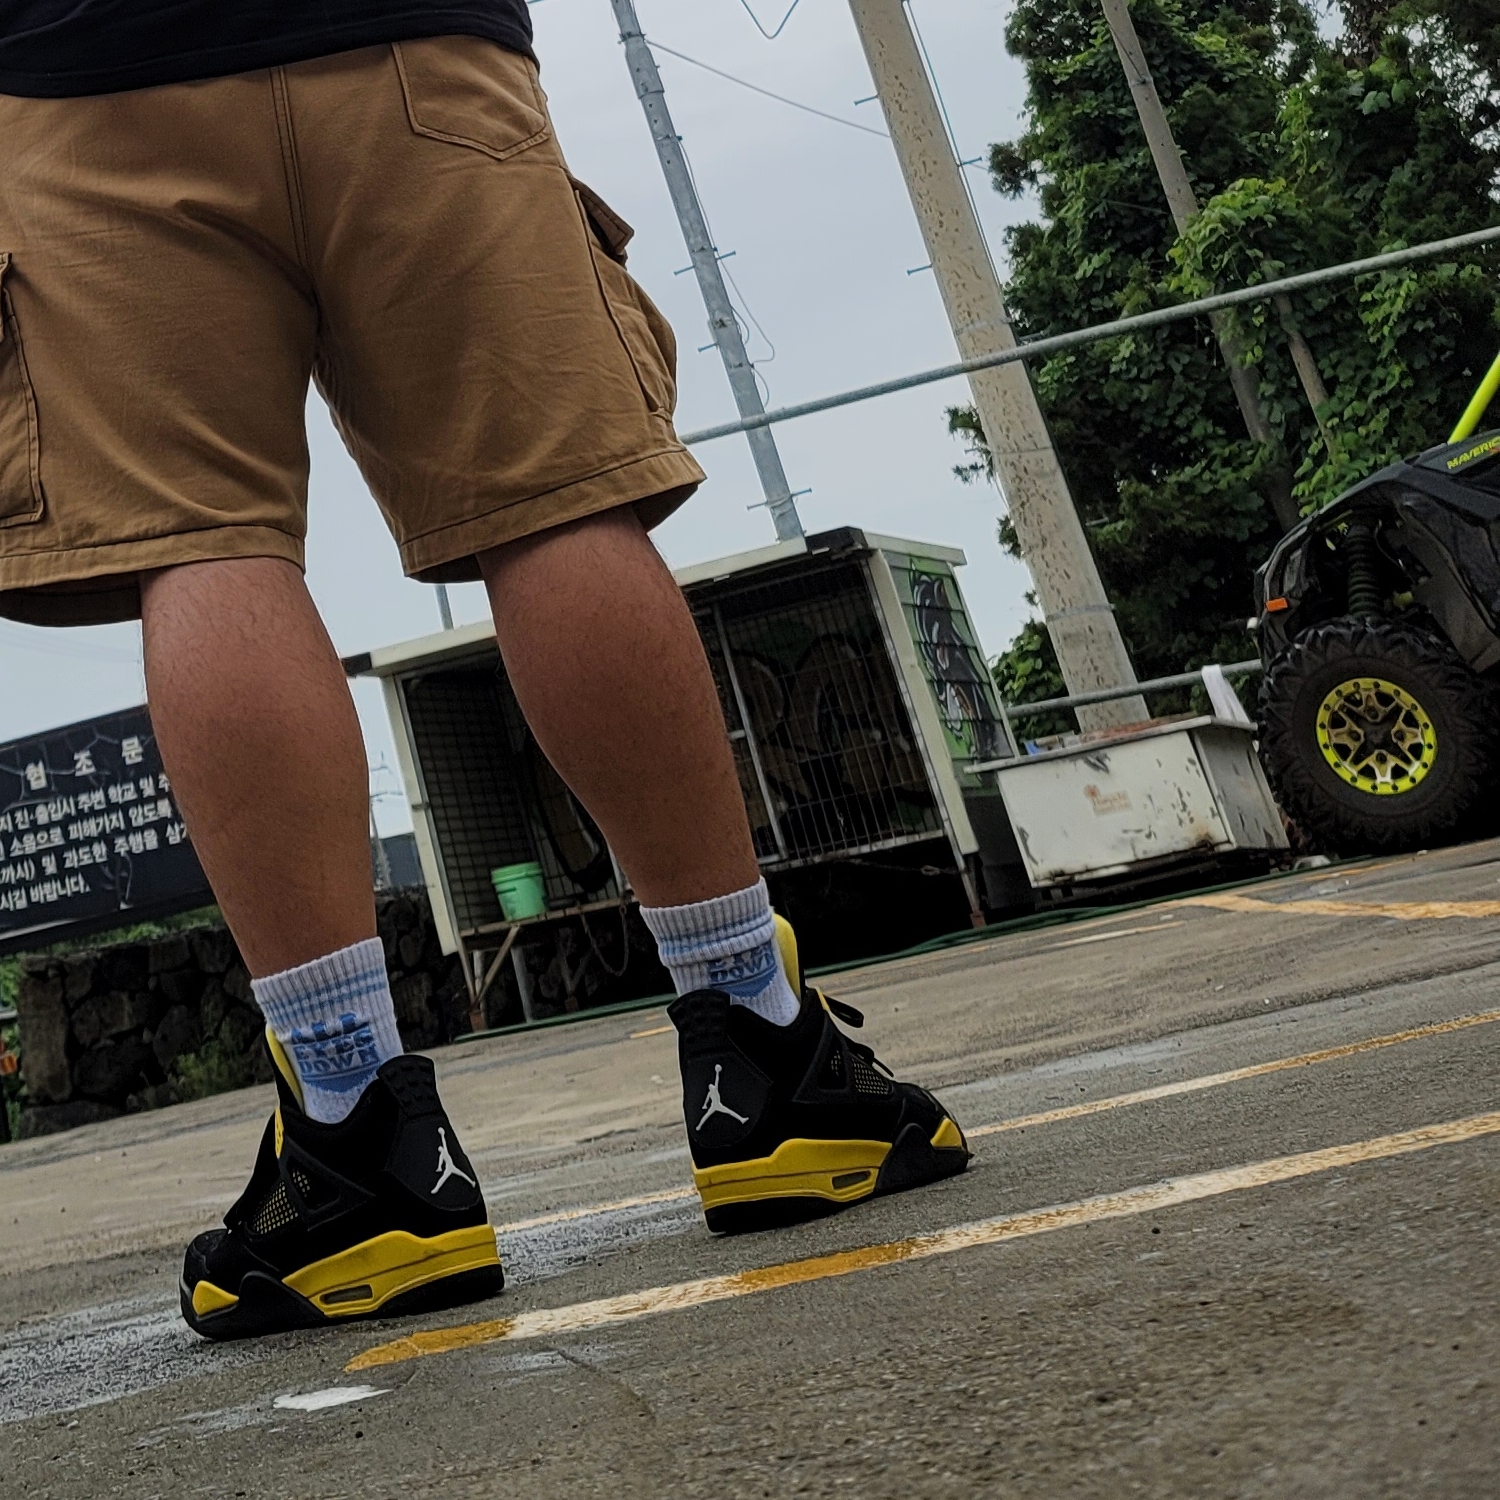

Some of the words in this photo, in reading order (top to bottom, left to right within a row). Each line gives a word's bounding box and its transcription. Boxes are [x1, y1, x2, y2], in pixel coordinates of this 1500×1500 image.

[78, 787, 107, 813] 주변
[108, 781, 138, 804] 학교
[139, 774, 156, 798] 및
[9, 825, 66, 857] 소음으로
[68, 808, 126, 840] 피해가지
[128, 797, 173, 827] 않도록
[41, 852, 57, 876] 및
[63, 839, 107, 869] 과도한
[114, 828, 158, 857] 주행을
[30, 871, 90, 904] 바랍니다.
